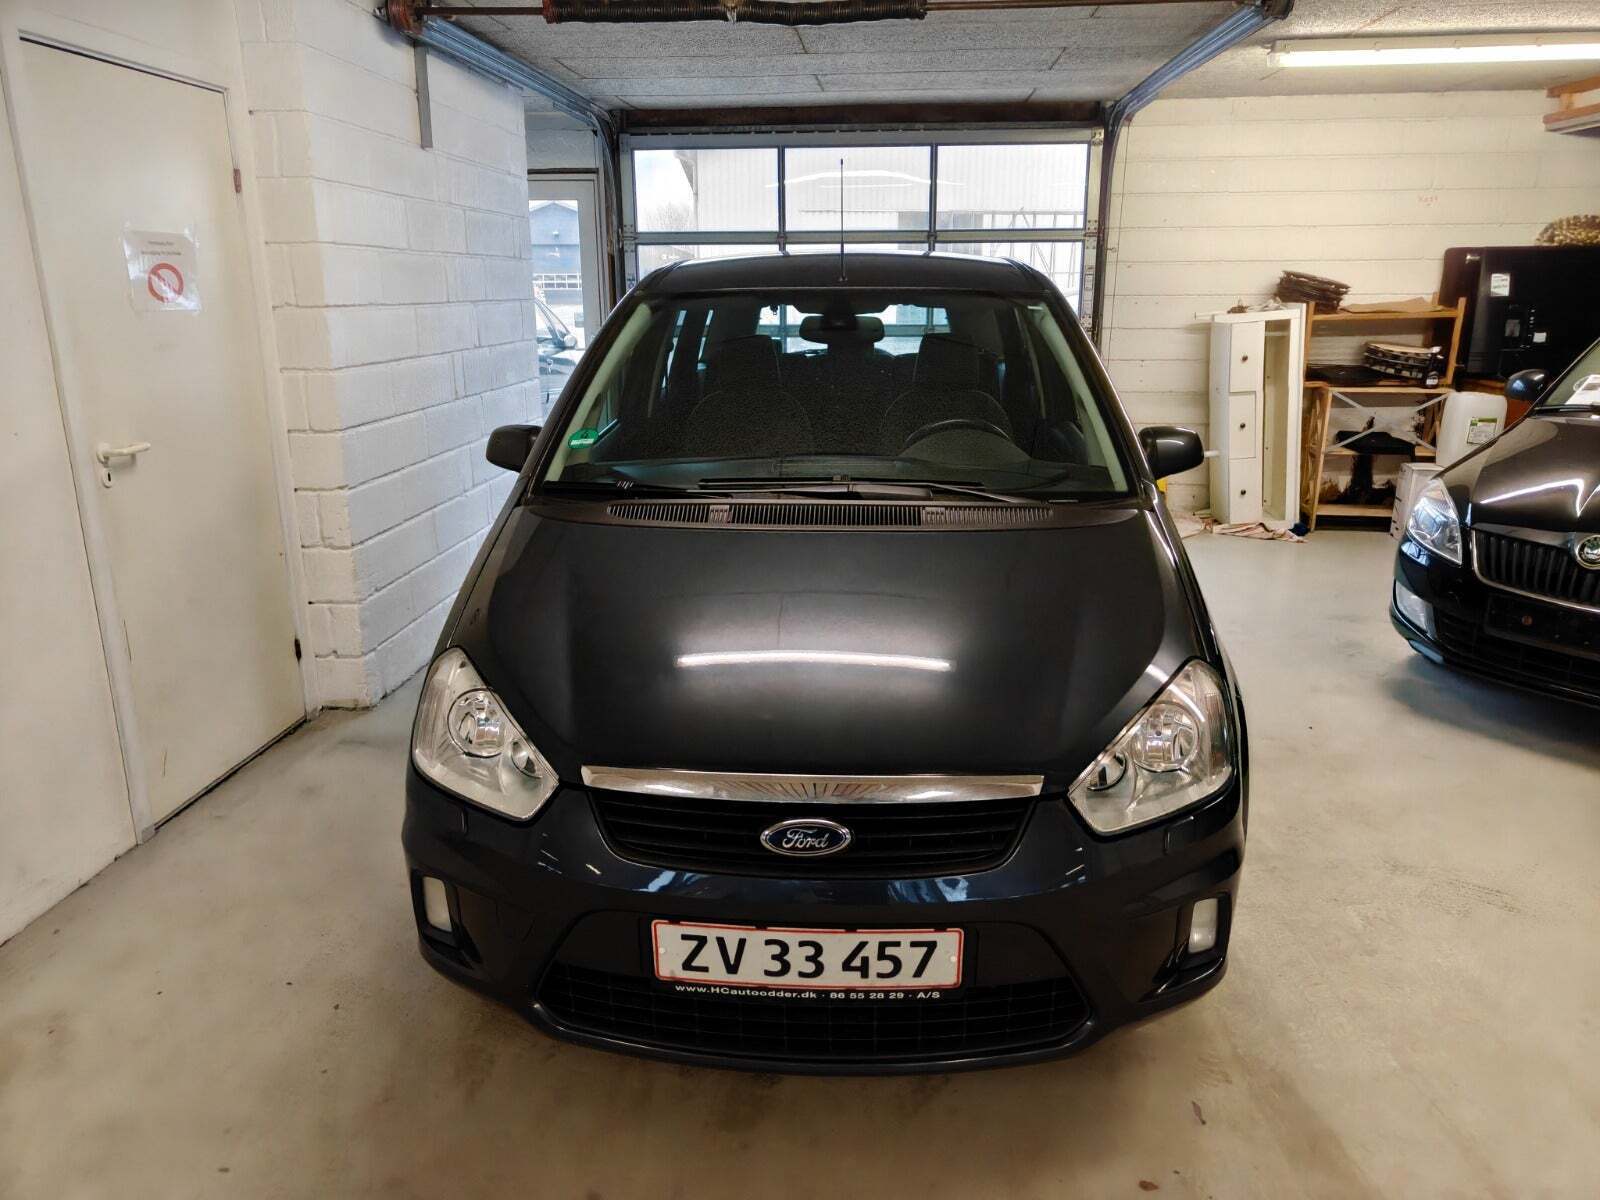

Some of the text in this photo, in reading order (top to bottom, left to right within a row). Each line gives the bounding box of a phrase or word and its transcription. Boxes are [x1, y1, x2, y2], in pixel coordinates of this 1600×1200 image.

[782, 828, 830, 848] Ford
[681, 934, 938, 979] ZV 33 457
[675, 984, 817, 999] www.HCautoodder.dk
[849, 991, 865, 999] 55
[869, 991, 885, 999] 28
[888, 991, 904, 999] 29
[916, 991, 940, 999] A/S
